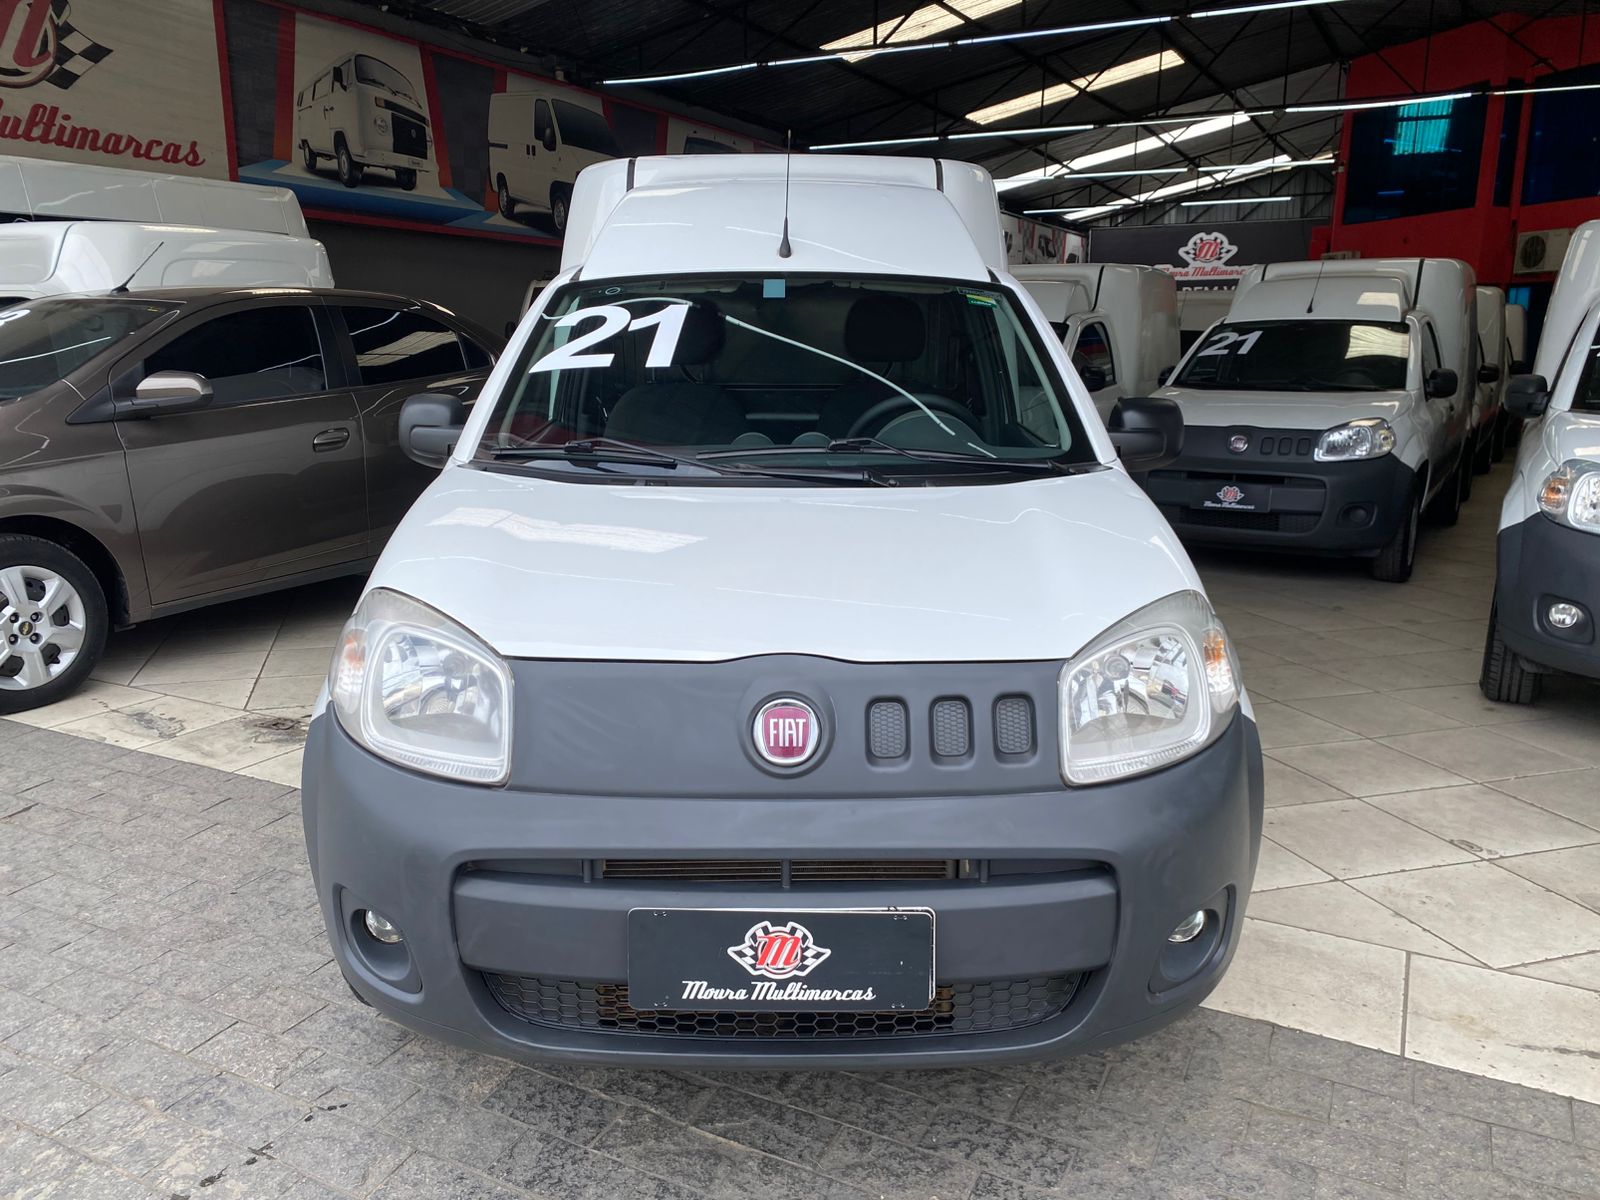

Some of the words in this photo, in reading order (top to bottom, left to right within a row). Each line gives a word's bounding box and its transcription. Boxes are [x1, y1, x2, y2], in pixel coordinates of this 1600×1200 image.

[0, 98, 206, 167] ultimarcas
[528, 304, 689, 374] 21
[1197, 330, 1264, 357] 21
[769, 718, 807, 747] FIAT
[681, 980, 749, 1000] Moura
[750, 981, 877, 1001] Multimarcas
